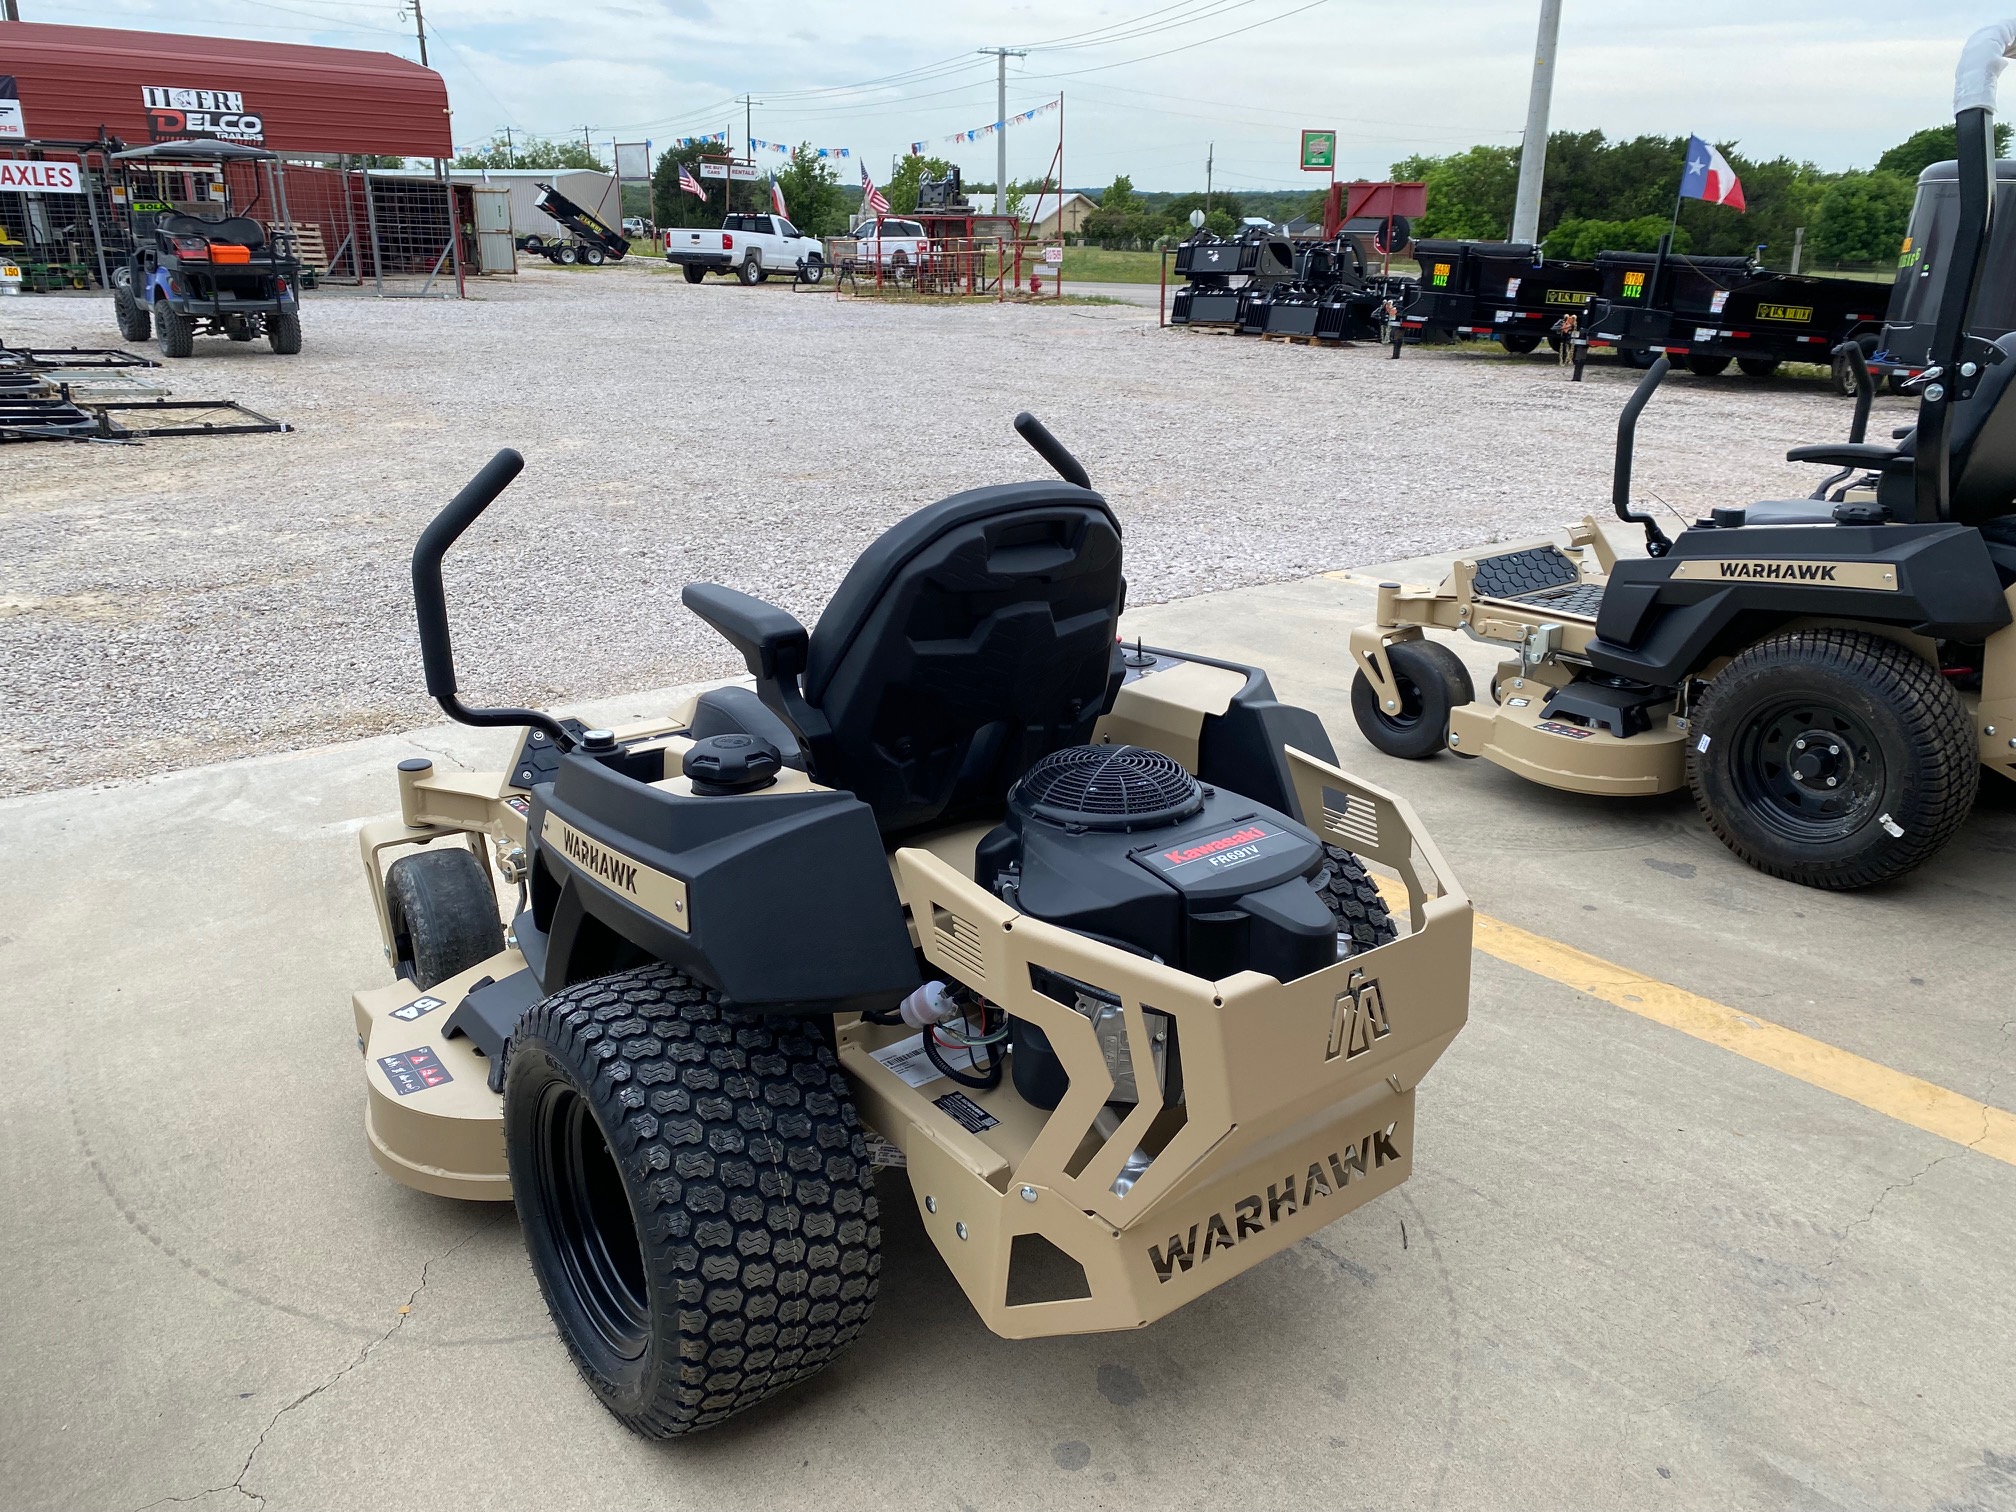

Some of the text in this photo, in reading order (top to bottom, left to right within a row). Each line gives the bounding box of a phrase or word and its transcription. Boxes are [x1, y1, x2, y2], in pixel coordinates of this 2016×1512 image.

[150, 109, 262, 134] DELCO
[215, 131, 264, 141] TRAILERS
[0, 165, 73, 187] AXLES
[1720, 562, 1838, 581] WARHAWK
[1164, 826, 1266, 864] Kawasaki
[1208, 844, 1259, 866] FR691V
[563, 826, 638, 895] WARHAWK
[394, 998, 442, 1020] 54
[1147, 1121, 1402, 1284] WARHAWK
